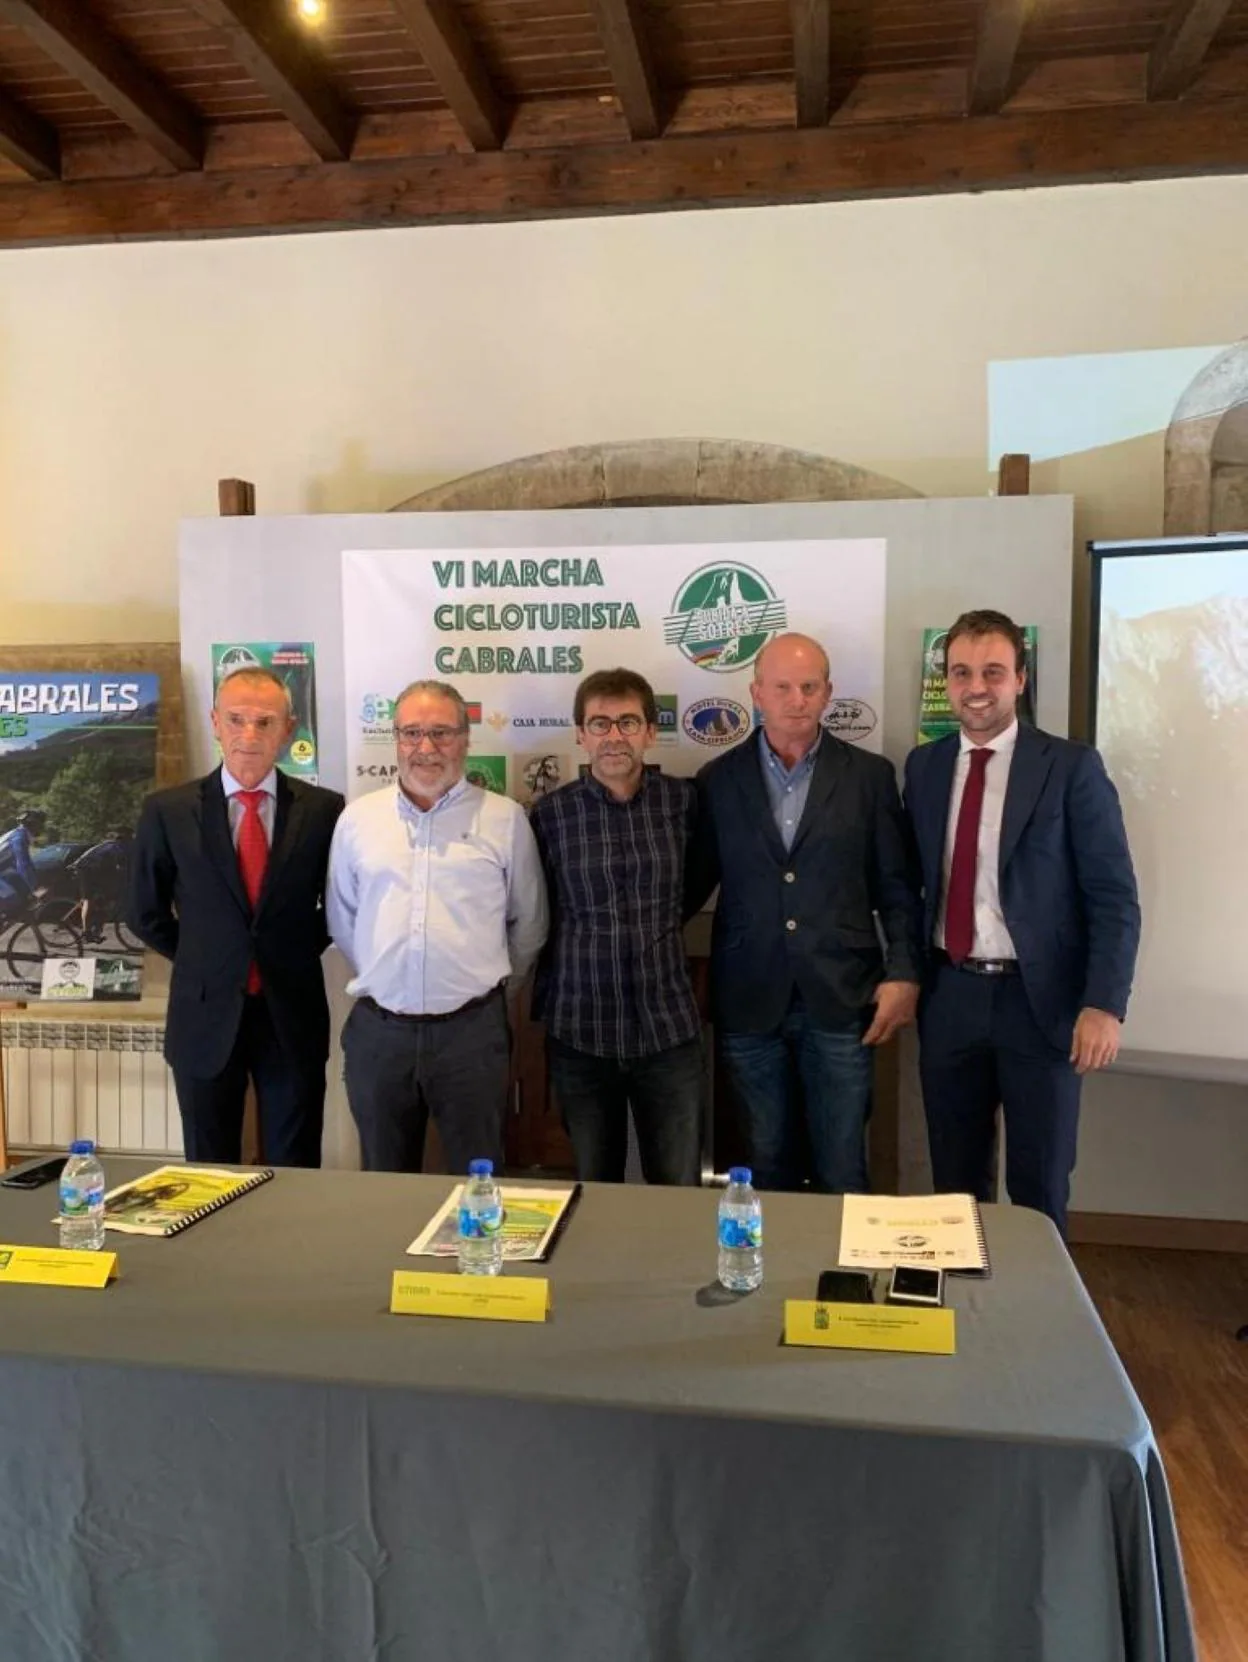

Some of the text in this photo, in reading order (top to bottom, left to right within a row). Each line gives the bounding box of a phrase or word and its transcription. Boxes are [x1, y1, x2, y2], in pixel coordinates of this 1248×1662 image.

[432, 558, 604, 588] VI MARCHA
[434, 602, 641, 631] CICLOTURISTA
[435, 646, 584, 674] CABRALES
